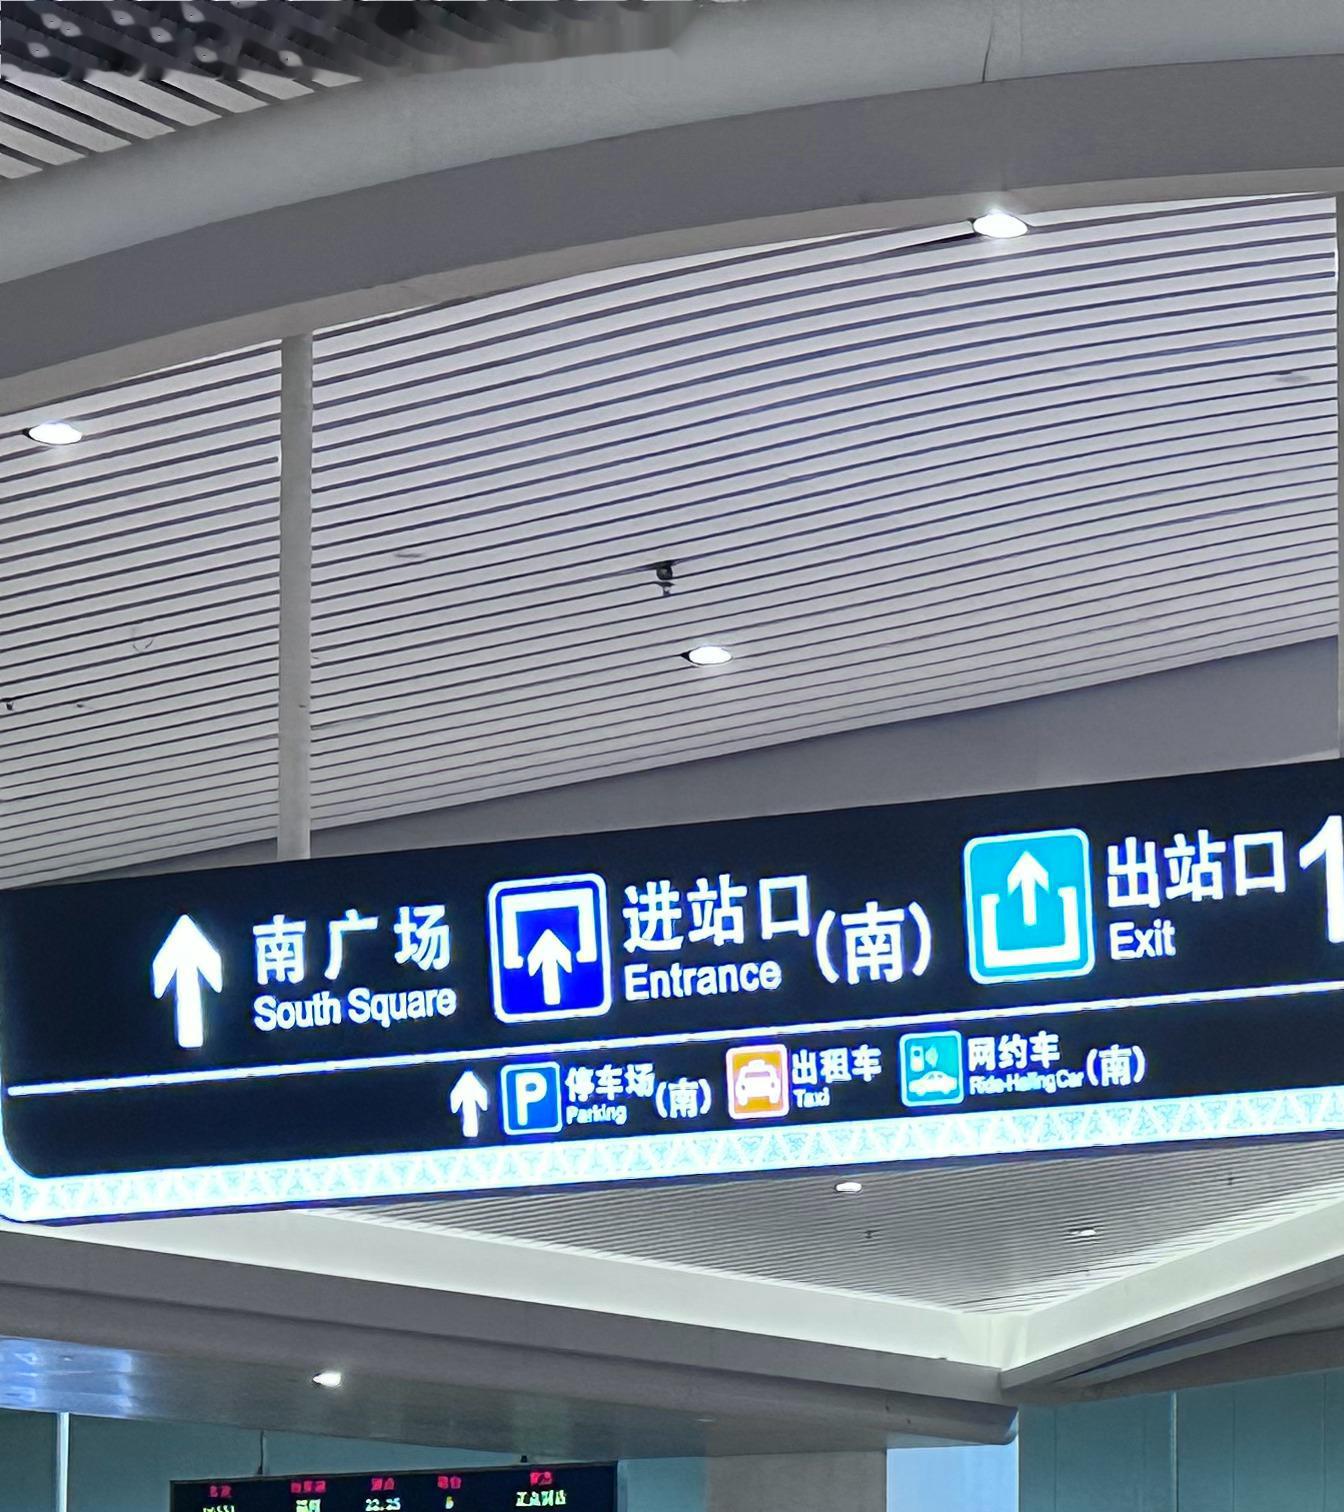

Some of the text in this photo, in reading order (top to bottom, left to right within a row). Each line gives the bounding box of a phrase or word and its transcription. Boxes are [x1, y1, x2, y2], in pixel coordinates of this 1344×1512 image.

[1107, 829, 1286, 908] 出站口
[253, 905, 450, 984] 南广场
[622, 873, 932, 984] 进站口 (南)
[1109, 919, 1176, 960] Exit
[624, 960, 782, 1001] Entrance
[254, 988, 456, 1031] South Square
[792, 1044, 882, 1085] 出租车
[967, 1030, 1146, 1087] 网约车 (南)
[515, 1072, 547, 1125] P
[565, 1064, 712, 1118] 停车场 (南)
[566, 1104, 627, 1125] Parking
[793, 1086, 830, 1108] Taxi
